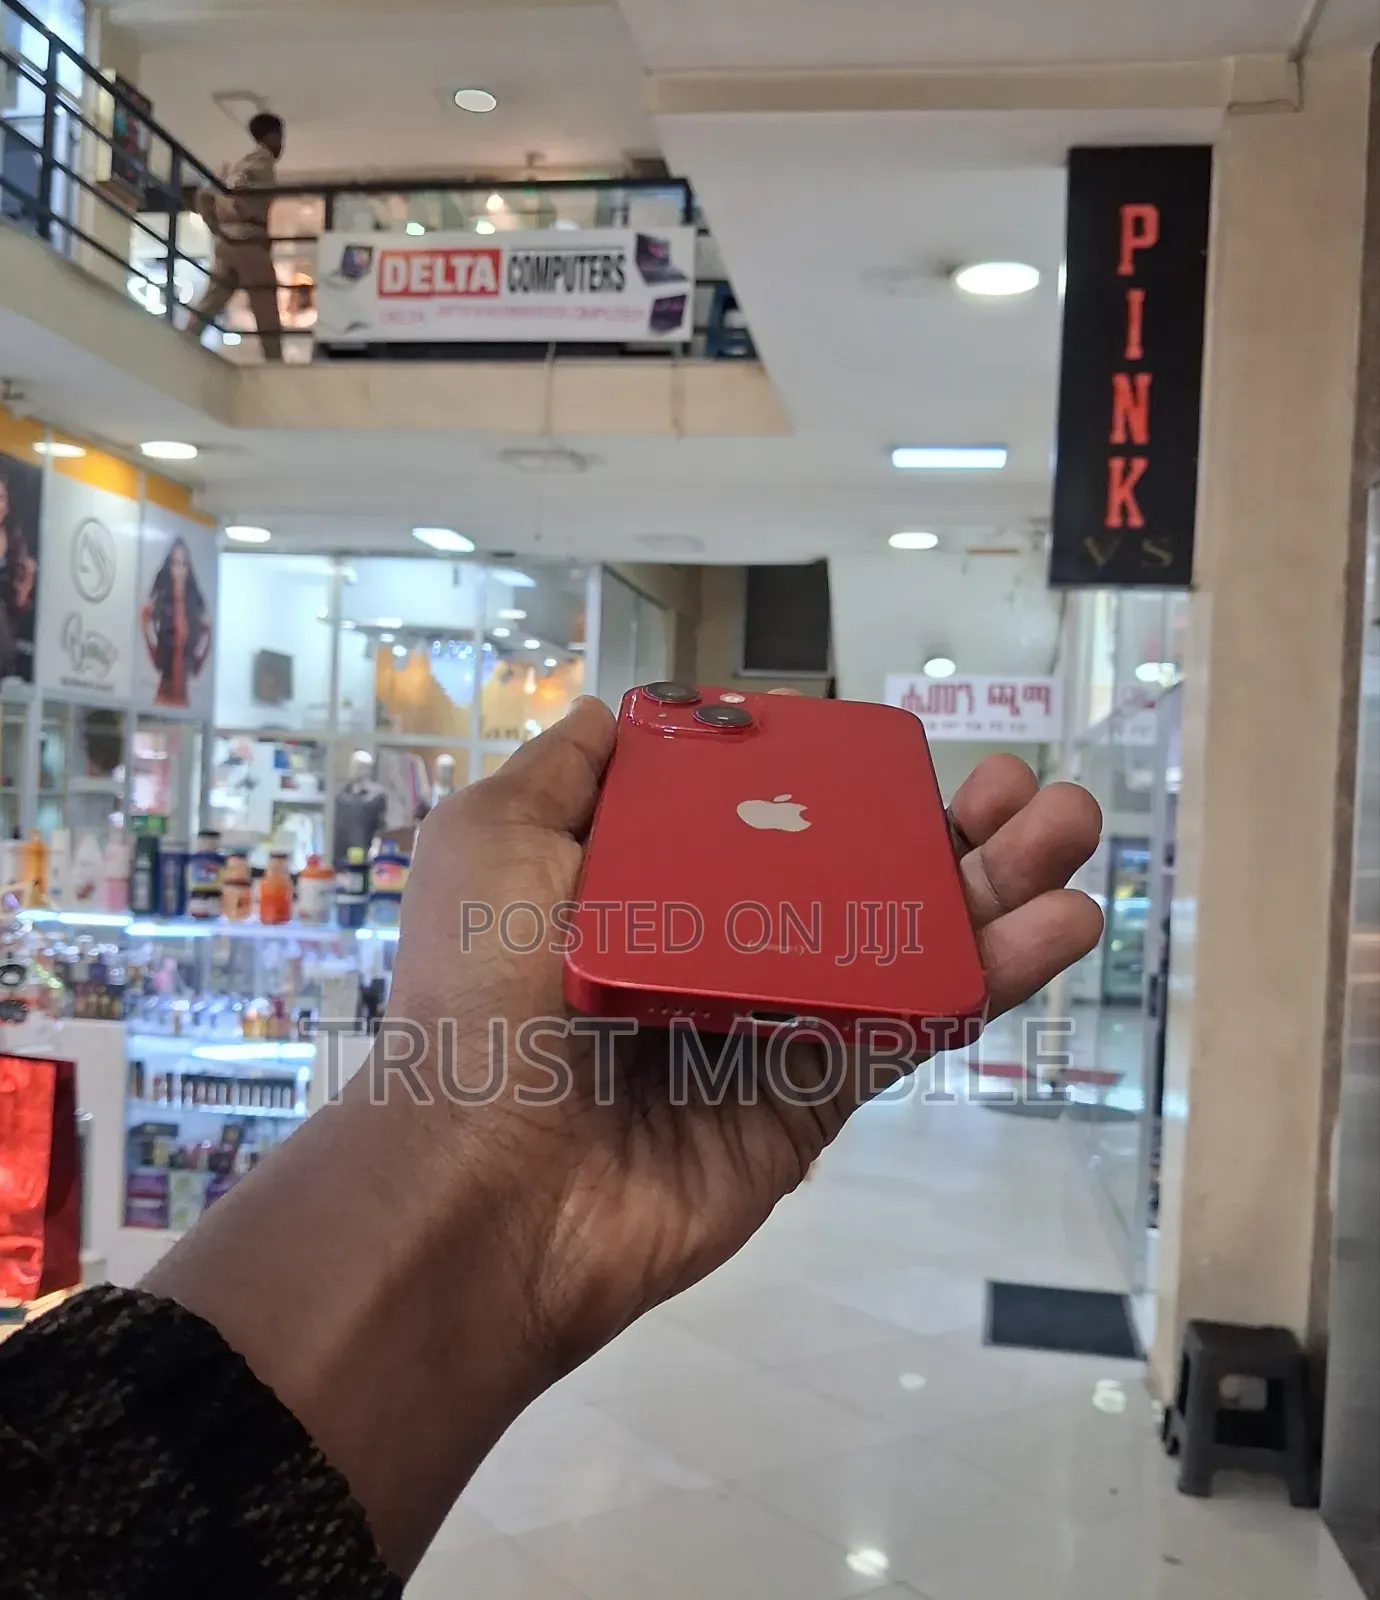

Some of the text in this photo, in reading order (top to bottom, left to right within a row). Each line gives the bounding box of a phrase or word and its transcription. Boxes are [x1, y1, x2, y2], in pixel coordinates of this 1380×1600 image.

[381, 253, 626, 294] DELTA COMPUTERS
[1104, 203, 1161, 528] PINK
